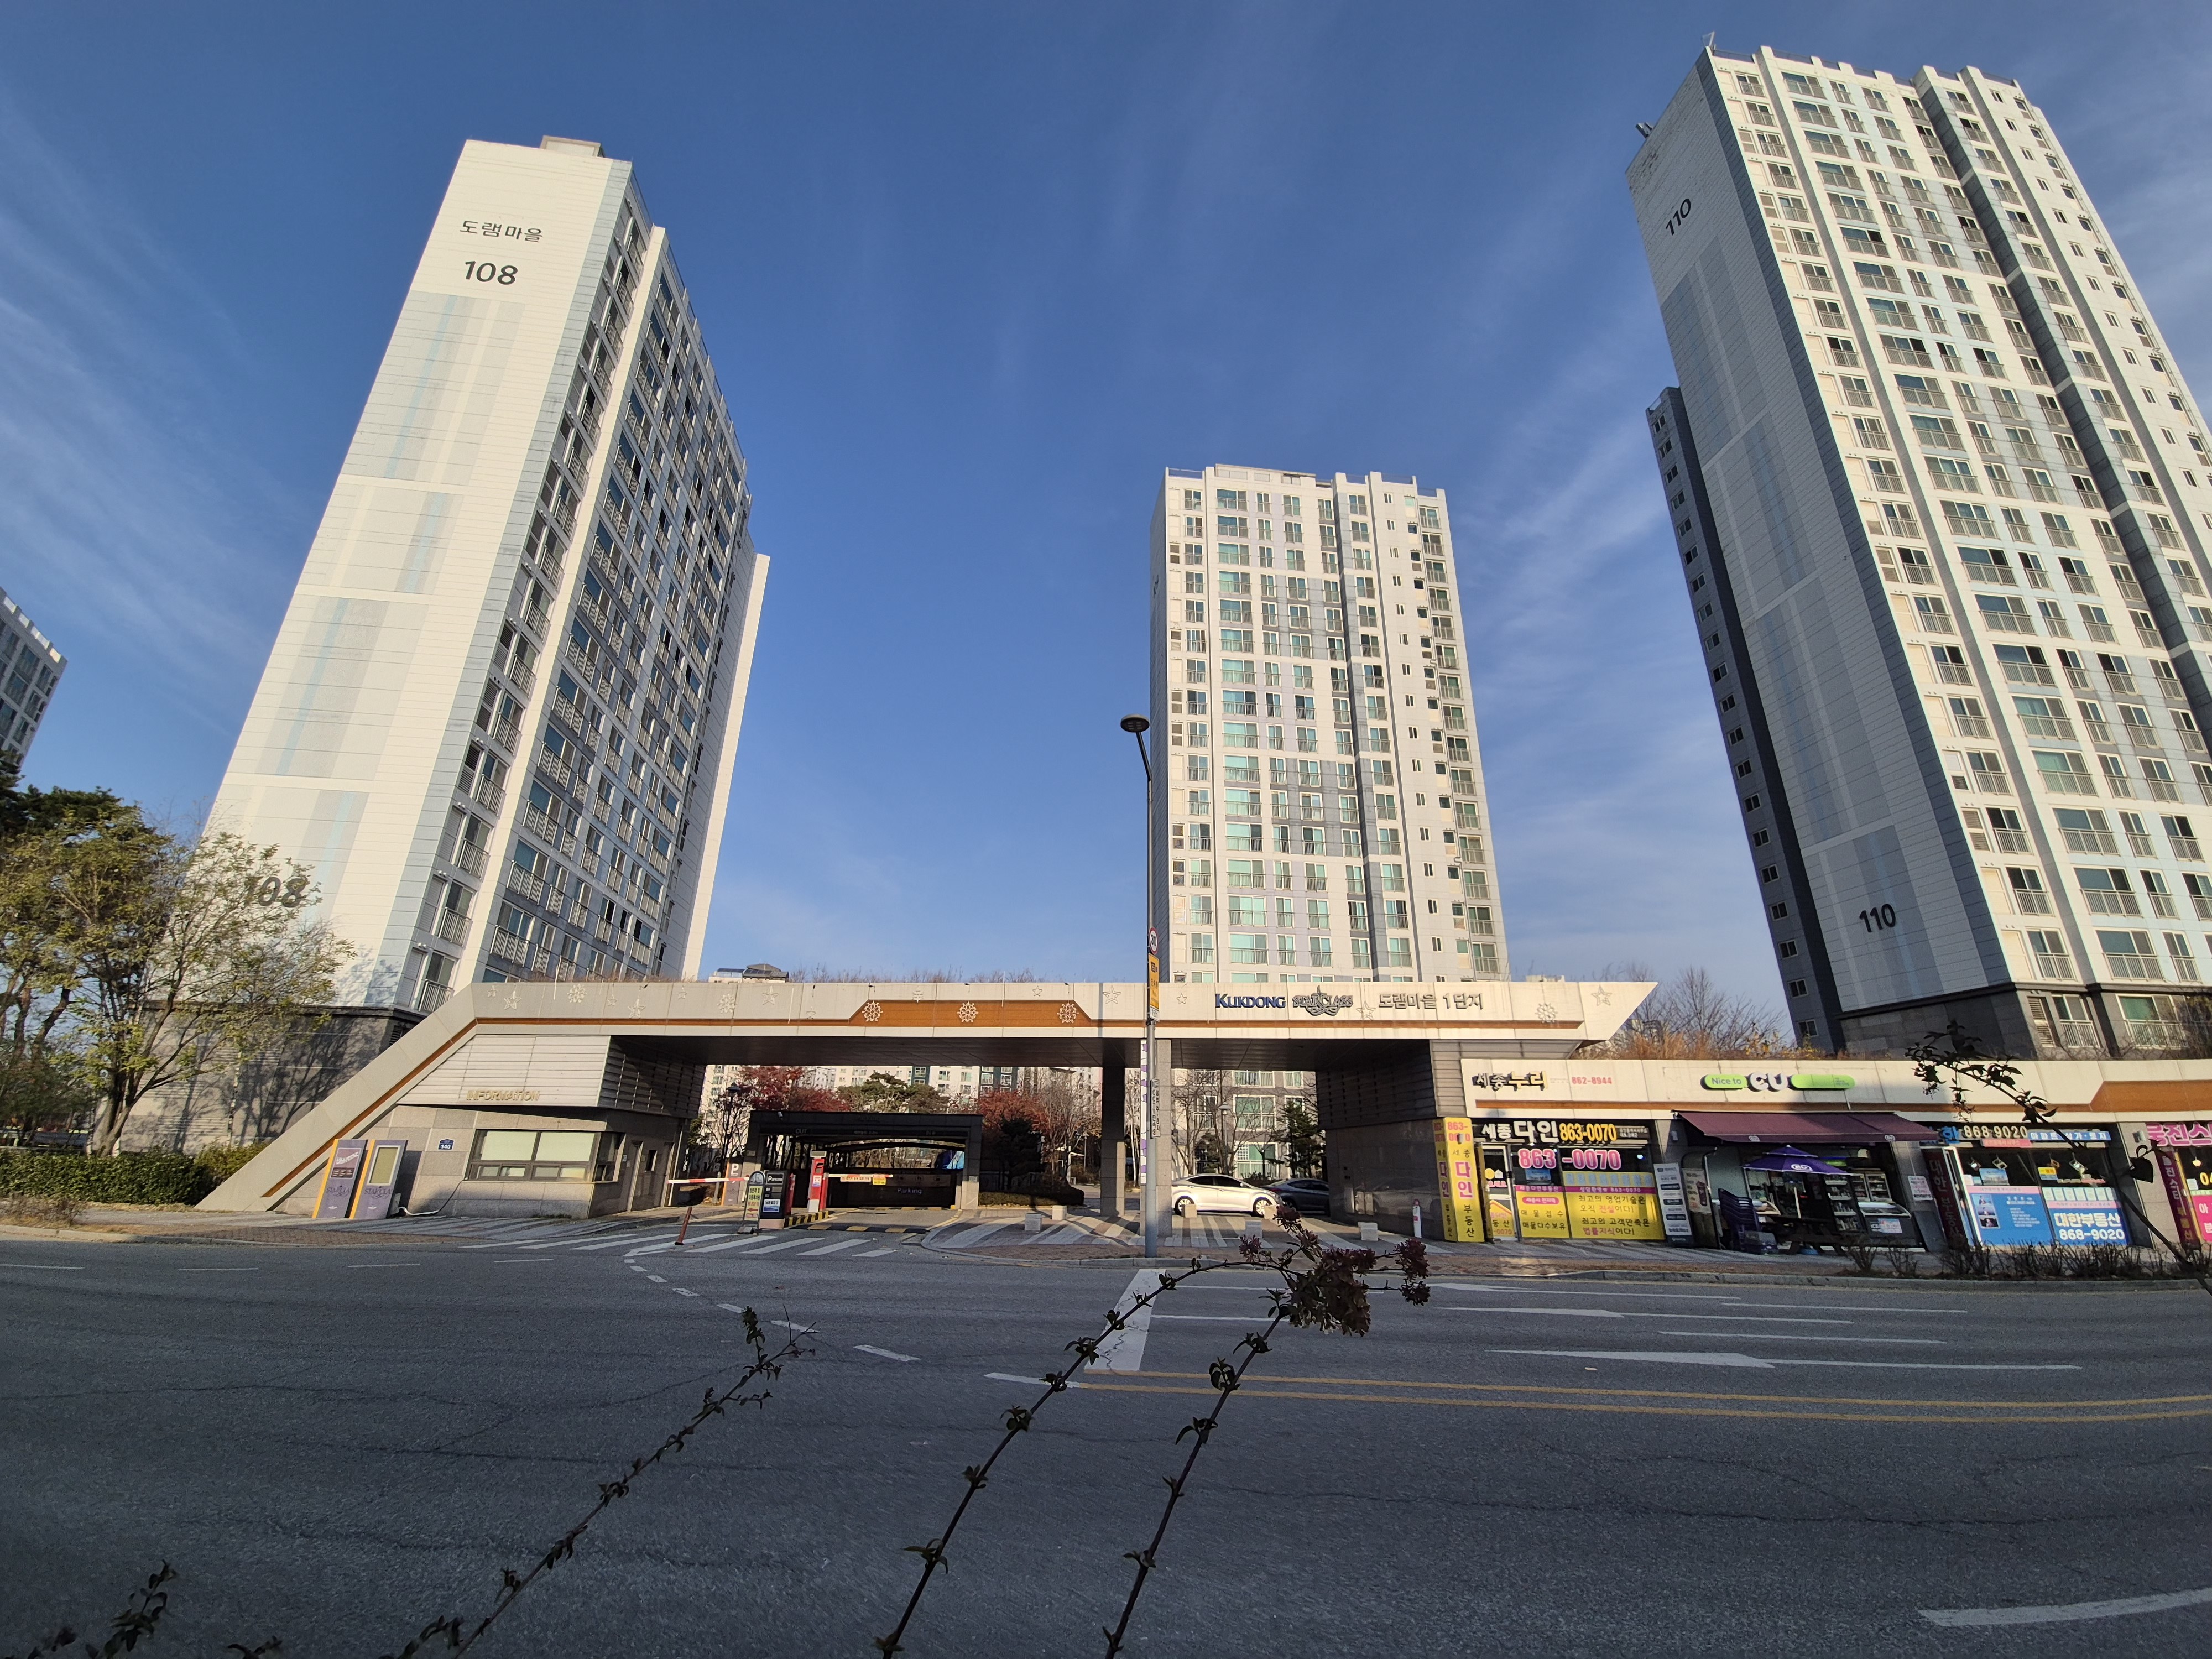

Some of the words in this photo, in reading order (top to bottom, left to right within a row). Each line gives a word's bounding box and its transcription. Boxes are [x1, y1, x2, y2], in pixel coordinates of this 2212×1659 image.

[1665, 198, 1692, 236] 110
[460, 220, 542, 242] 도램마을
[465, 260, 518, 285] 108
[1859, 904, 1896, 932] 110
[1151, 934, 1156, 947] 30
[1215, 993, 1286, 1008] KUKDONG
[1379, 993, 1437, 1010] 도램마을
[1572, 1076, 1613, 1084] 862-8944
[1749, 1072, 1788, 1092] CU
[466, 1090, 540, 1101] INFORMATION
[1559, 1123, 1618, 1141] 863-0070
[1963, 1125, 2028, 1139] 868-9020
[1579, 1194, 1602, 1202] 최고의
[1605, 1195, 1646, 1204] 영업기술은
[1463, 1204, 1475, 1238] 부동산
[2053, 1213, 2121, 1227] 대한부동산
[2058, 1229, 2125, 1240] 868-9020
